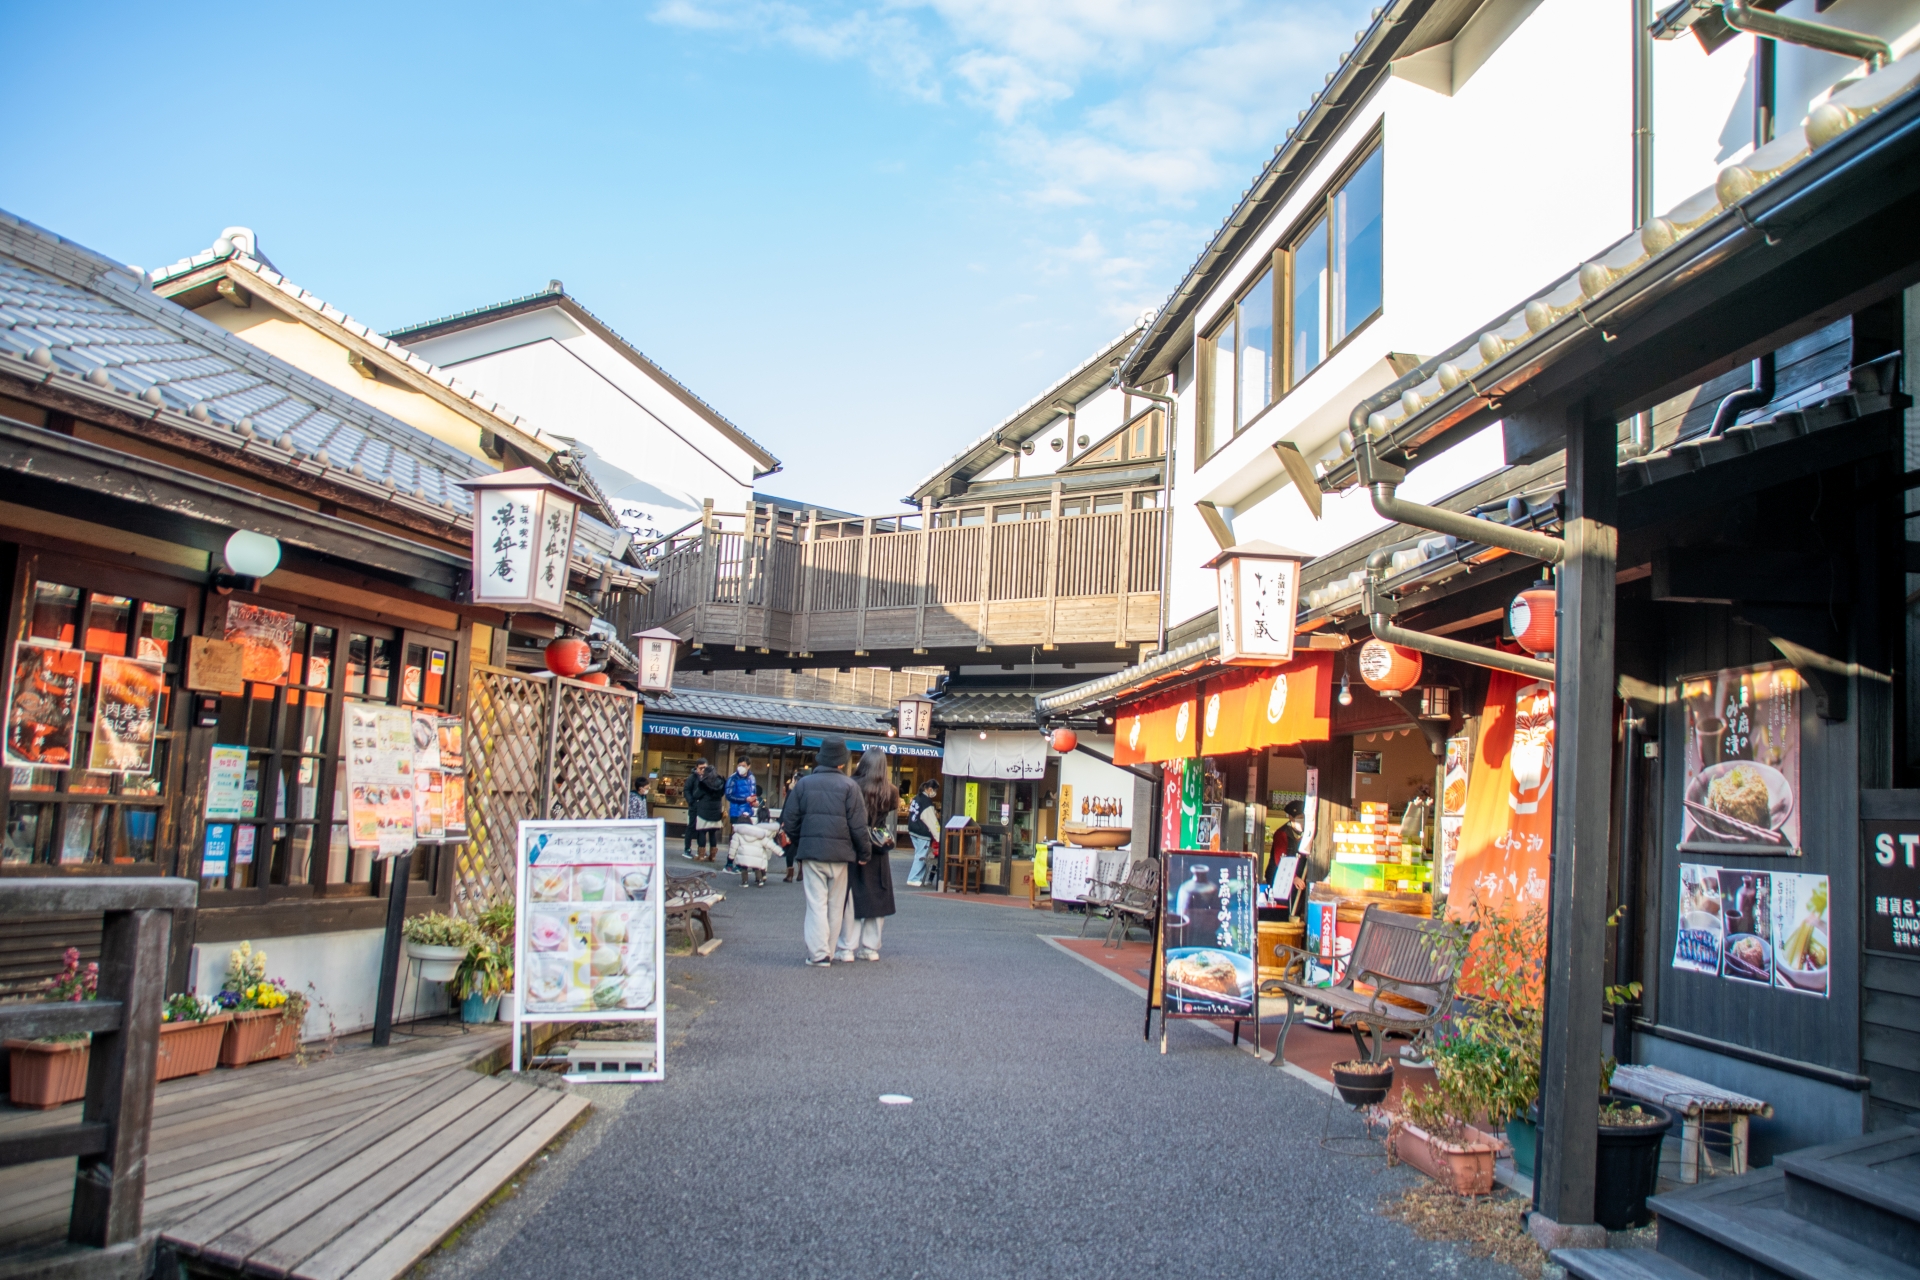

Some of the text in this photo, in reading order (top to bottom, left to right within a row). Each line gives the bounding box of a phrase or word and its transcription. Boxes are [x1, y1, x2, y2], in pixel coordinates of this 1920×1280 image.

[105, 702, 151, 720] 肉巻き
[649, 725, 740, 741] YUFUIN TSUBAMEYA
[898, 747, 938, 757] TSUBAMEYA
[1217, 868, 1233, 947] 豆腐のみそ漬
[1875, 896, 1920, 915] 雑貨&
